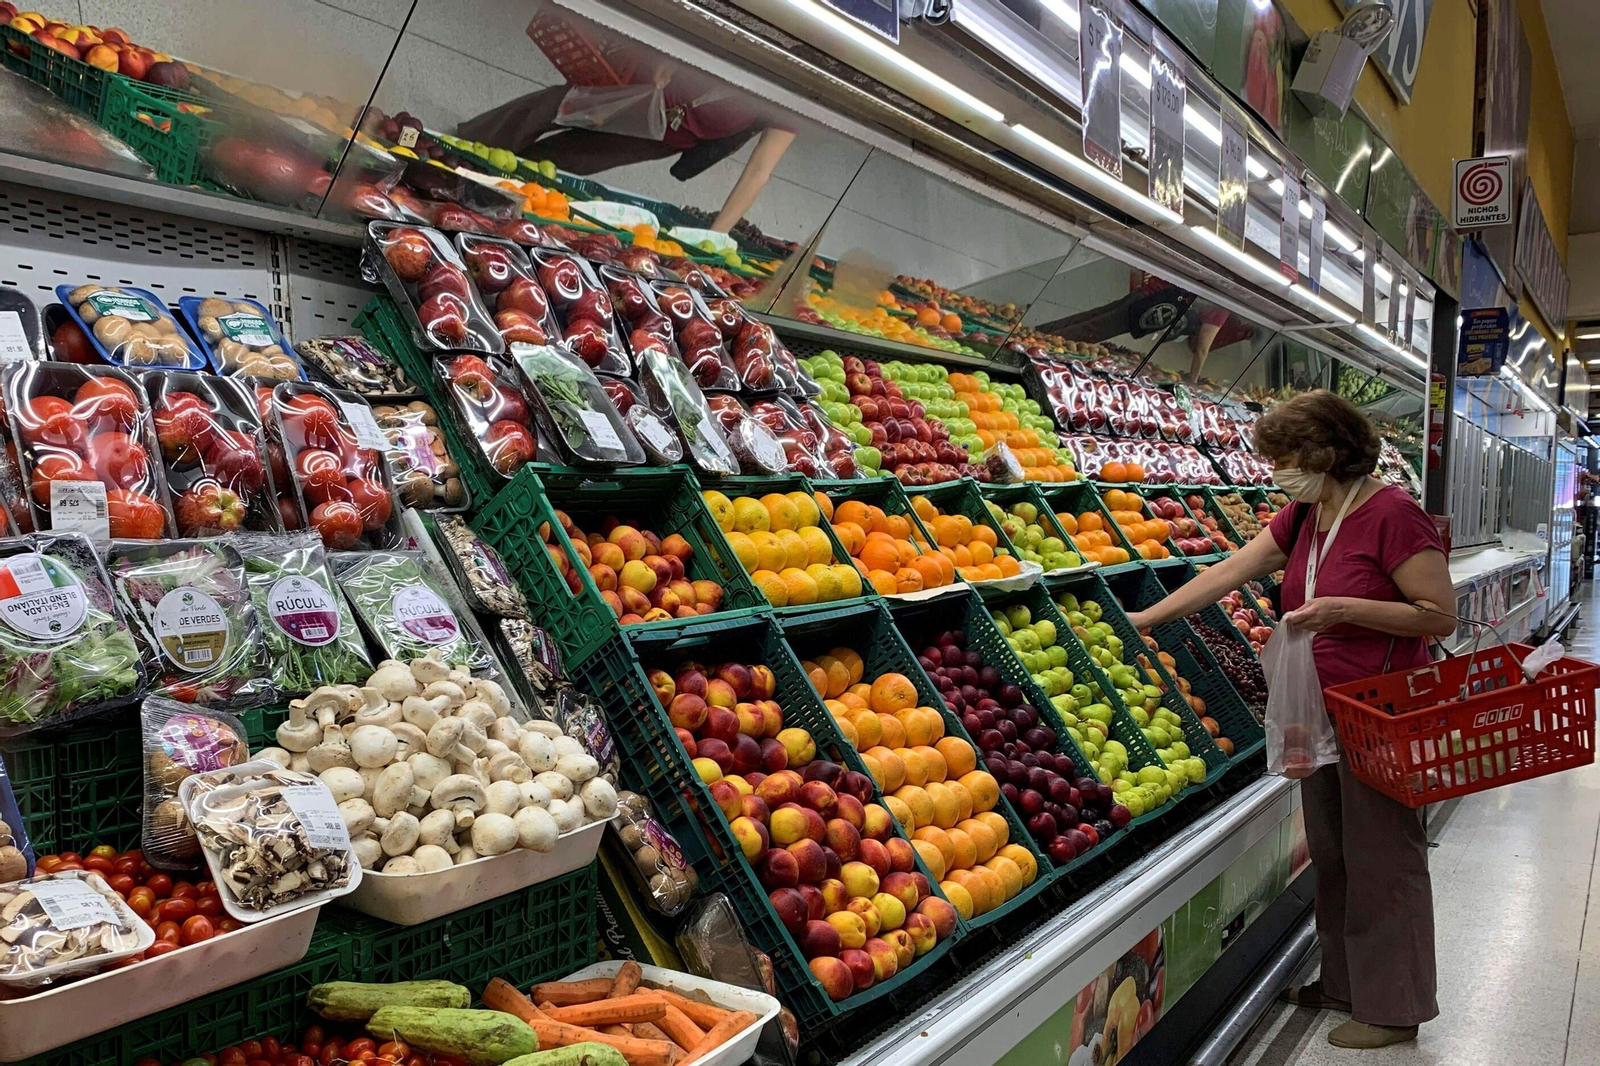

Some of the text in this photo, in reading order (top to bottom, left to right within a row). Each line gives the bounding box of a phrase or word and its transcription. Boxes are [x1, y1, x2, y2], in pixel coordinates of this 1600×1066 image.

[1467, 205, 1499, 214] NICHOS
[1460, 213, 1506, 223] HIDRANTES
[7, 597, 49, 612] ITALIANO
[50, 592, 77, 603] BLEND
[275, 596, 328, 612] RÚCULA
[23, 600, 70, 616] ENSALADA
[399, 603, 446, 617] RÚCULA
[179, 616, 190, 625] DE
[190, 614, 221, 624] VERDES
[1473, 703, 1524, 728] COTO
